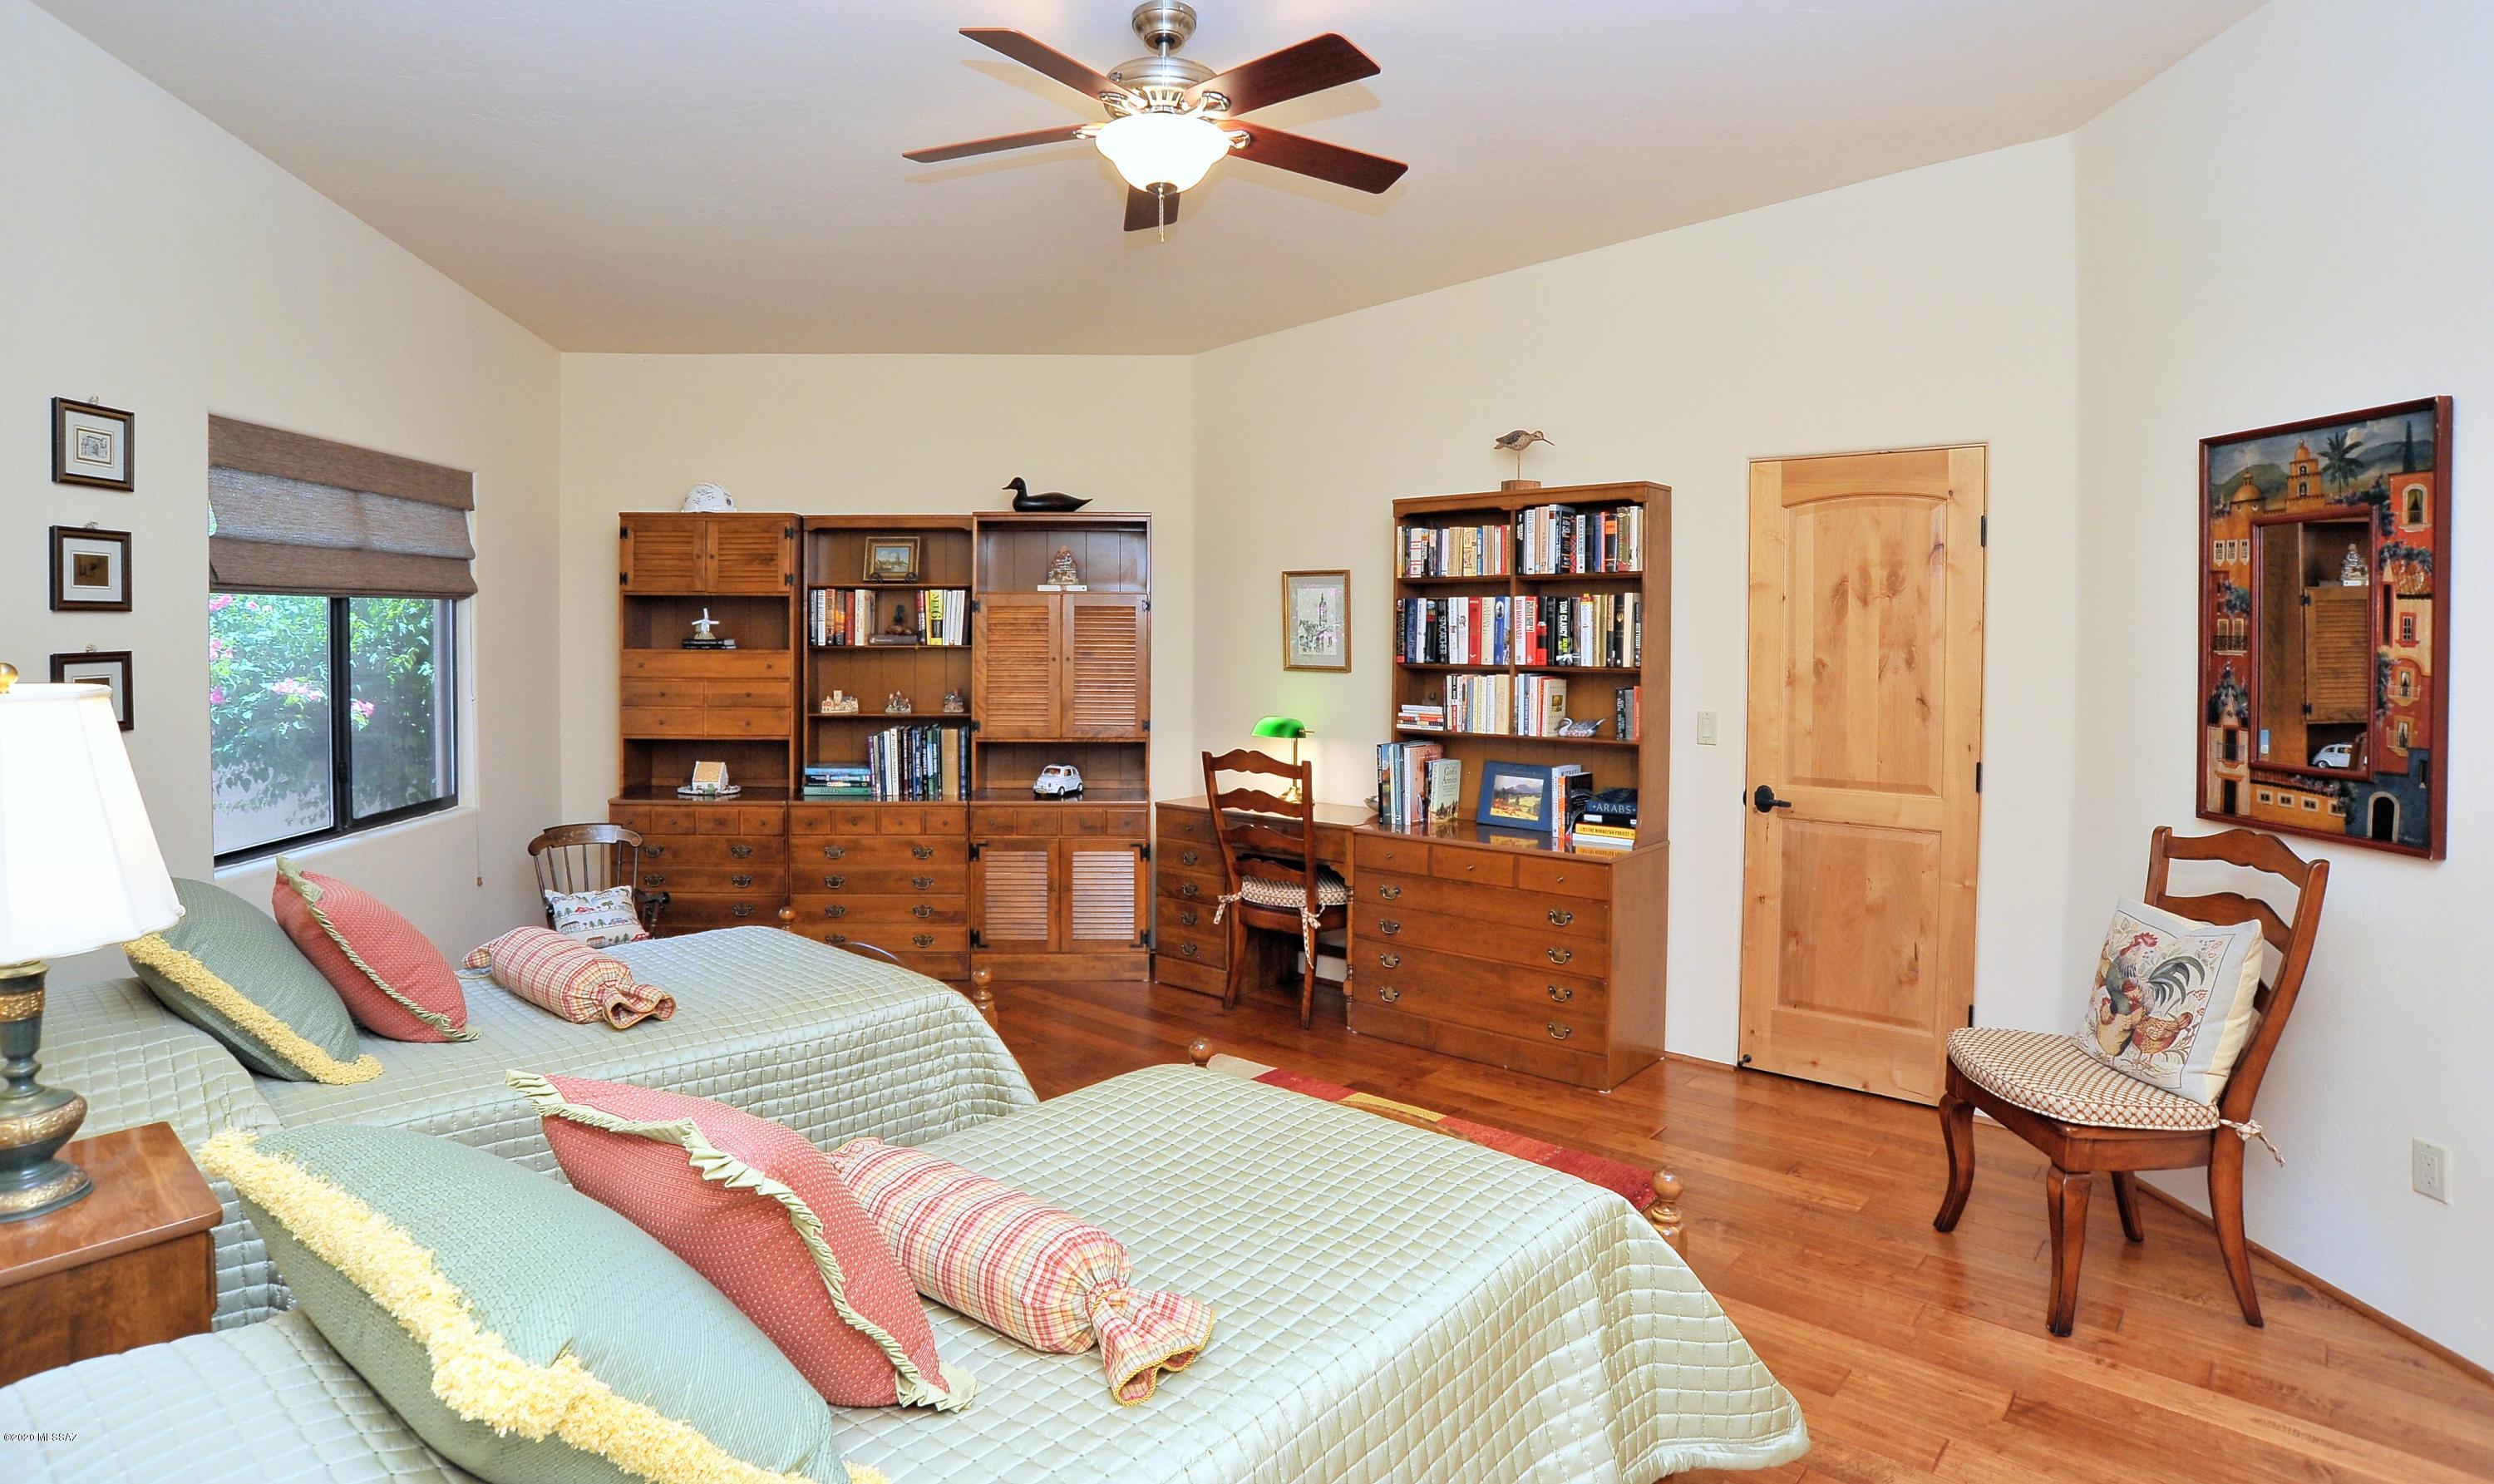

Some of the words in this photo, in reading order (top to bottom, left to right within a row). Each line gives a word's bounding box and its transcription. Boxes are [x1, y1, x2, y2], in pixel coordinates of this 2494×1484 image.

[1559, 600, 1568, 614] TOM
[1438, 615, 1447, 654] SPYCATCHER
[1559, 614, 1568, 638] CLANCY
[1595, 802, 1632, 814] ARABS
